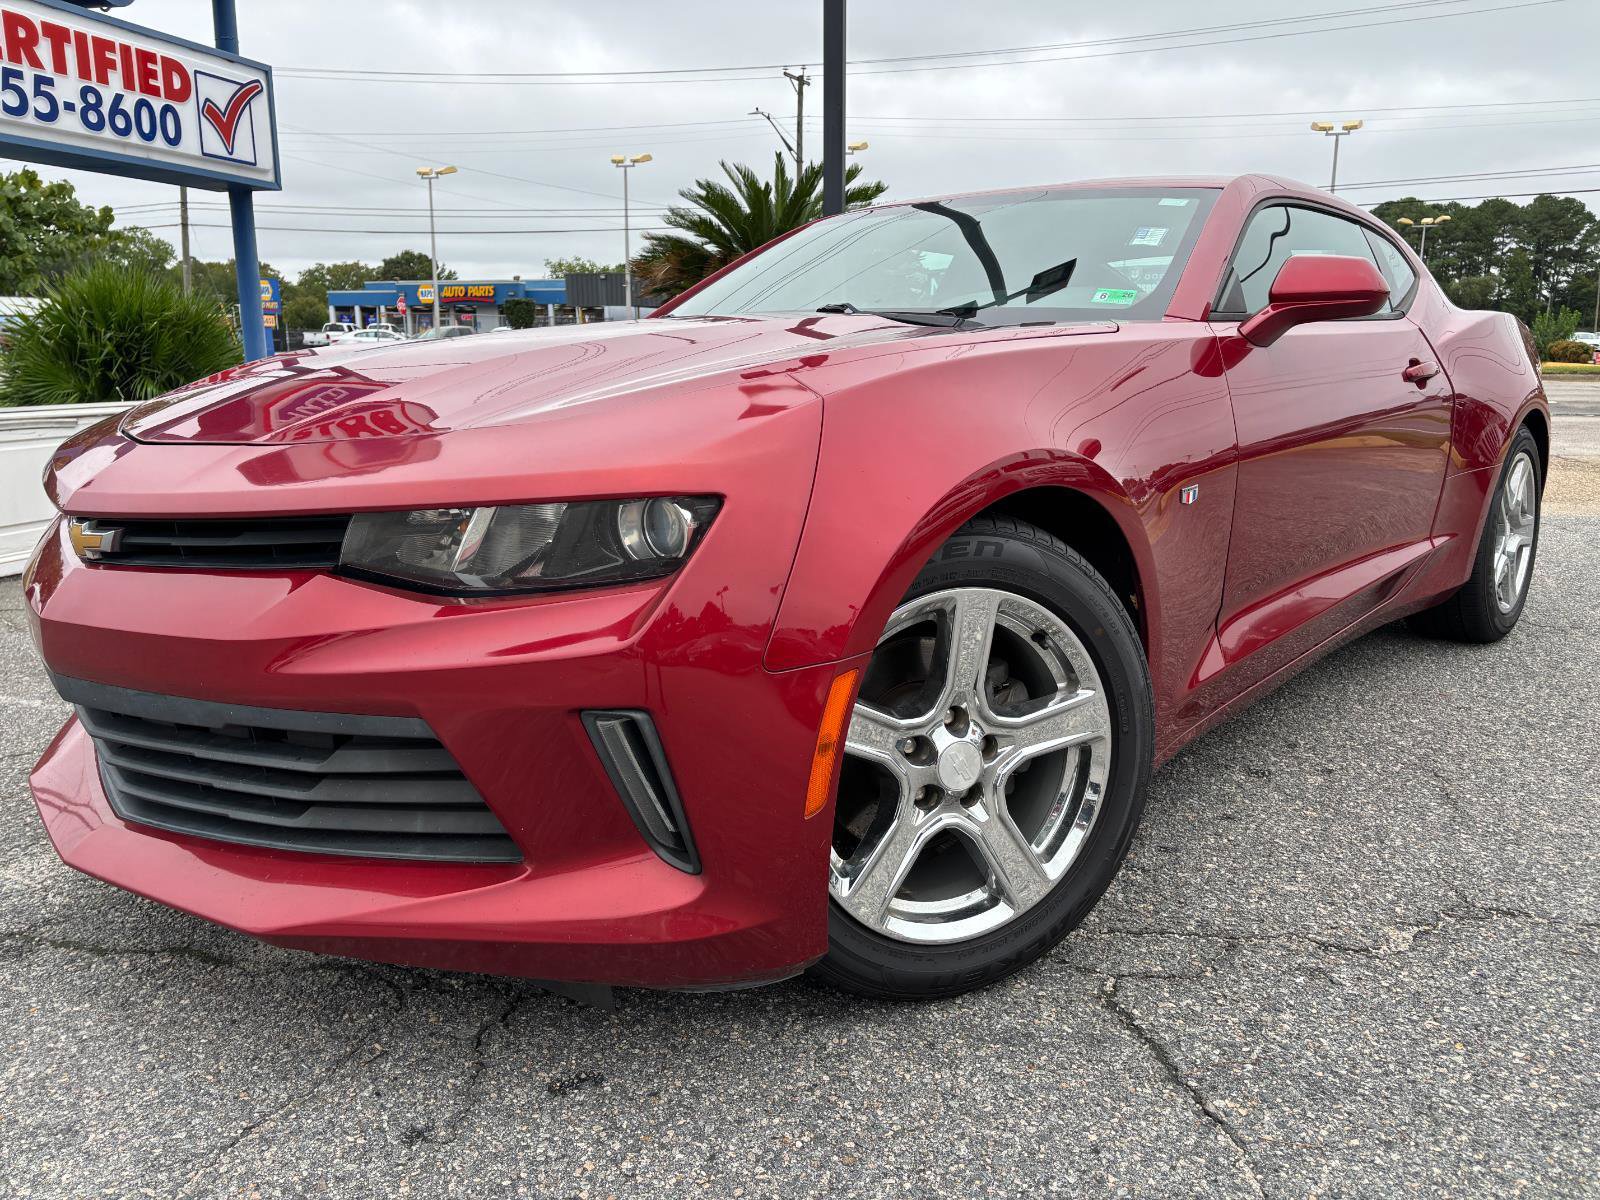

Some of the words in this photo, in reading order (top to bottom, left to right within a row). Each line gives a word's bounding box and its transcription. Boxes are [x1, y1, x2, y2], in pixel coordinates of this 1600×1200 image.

[0, 10, 191, 103] RTIFIED
[442, 286, 466, 297] AUTO
[467, 285, 495, 297] PARTS
